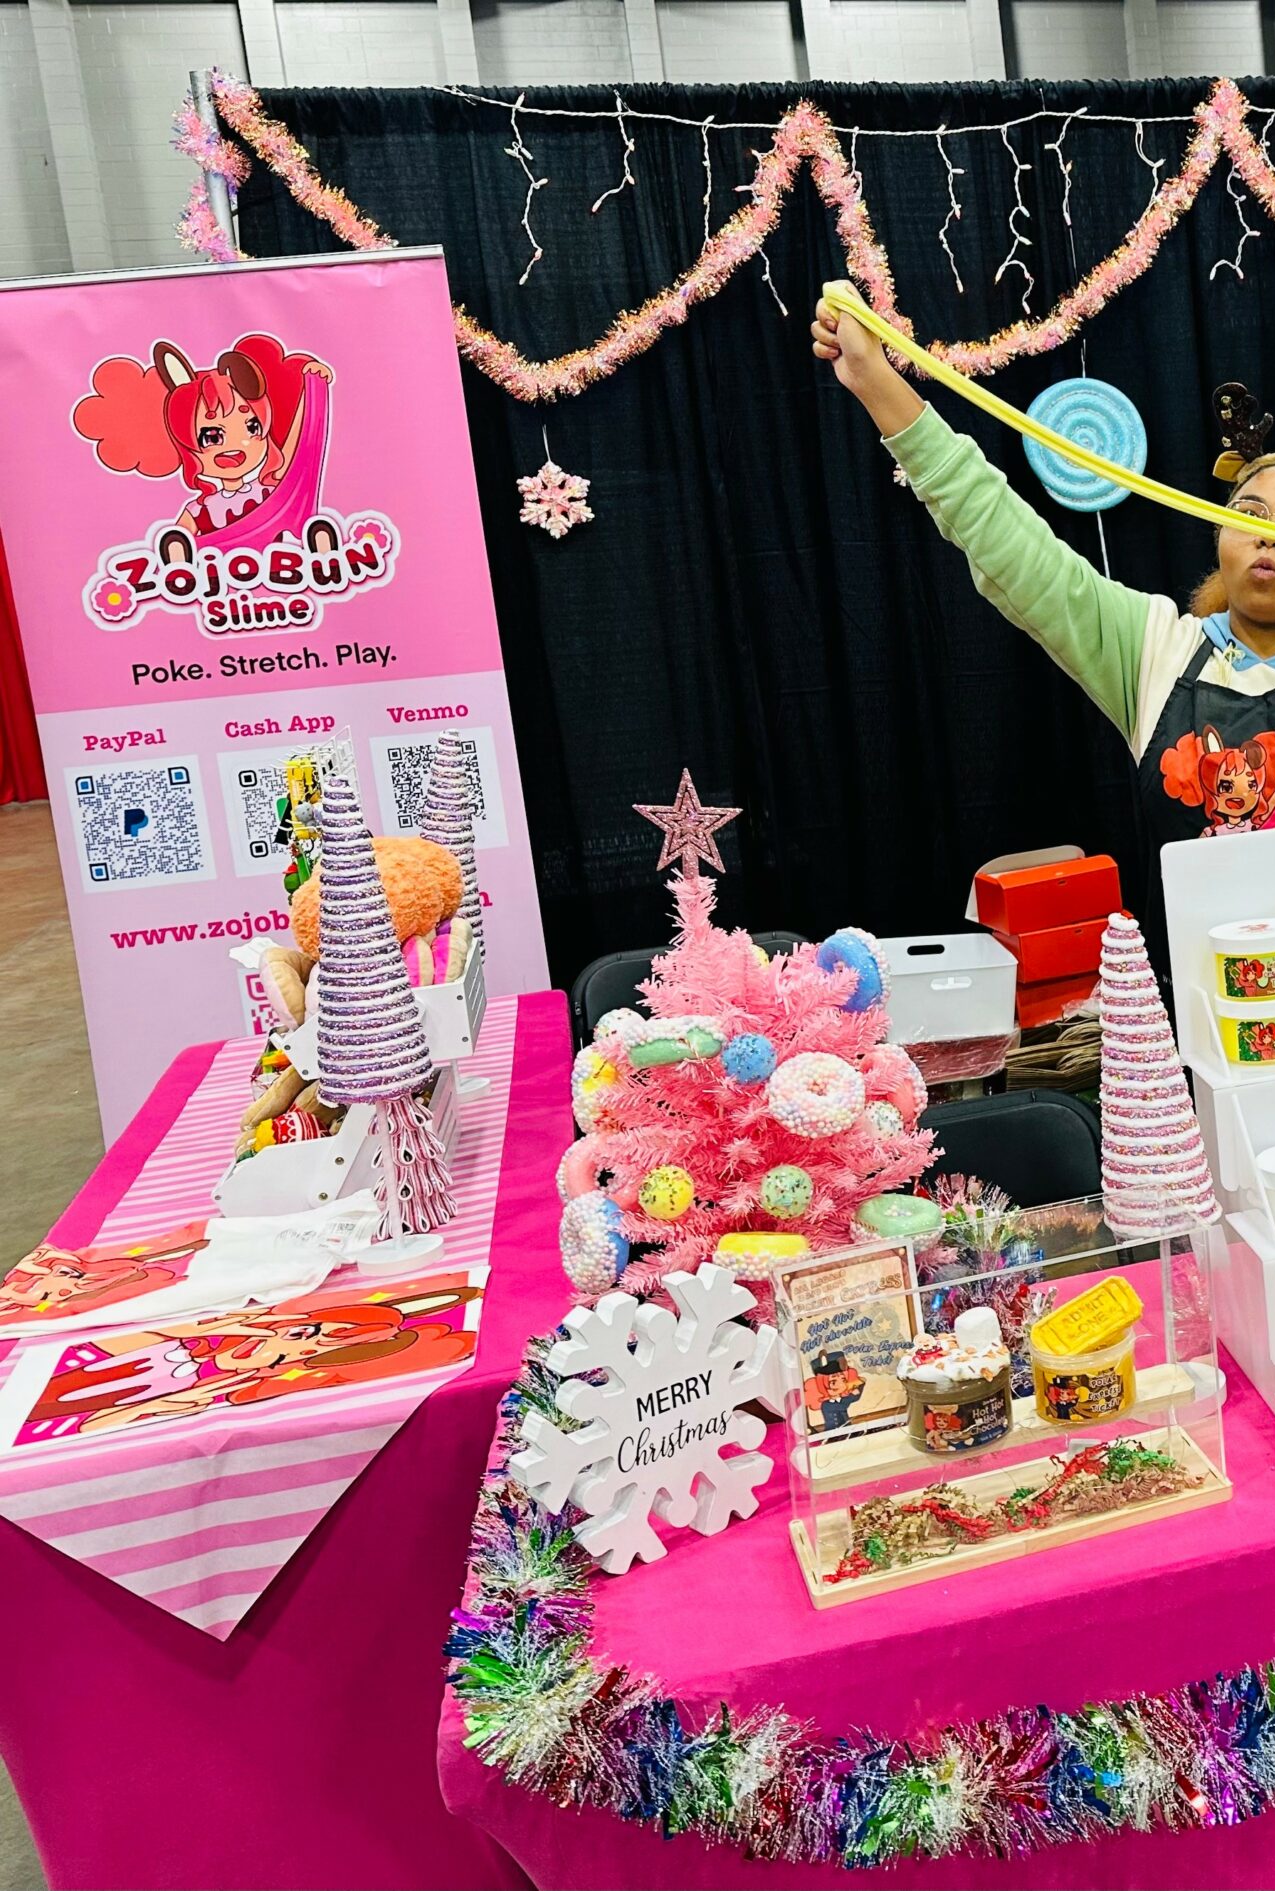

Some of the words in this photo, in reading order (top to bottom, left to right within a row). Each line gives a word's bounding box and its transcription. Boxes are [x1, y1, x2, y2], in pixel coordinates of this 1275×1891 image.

[207, 593, 310, 627] Slime
[132, 660, 212, 685] Poke.
[219, 647, 328, 677] Stretch.
[336, 642, 397, 667] Play.
[224, 719, 282, 739] Cash
[288, 714, 336, 733] App
[387, 703, 469, 724] Venmo
[83, 728, 167, 752] PayPal
[636, 1370, 712, 1422] MERRY
[972, 1407, 990, 1419] Hot
[617, 1410, 733, 1473] Christmas
